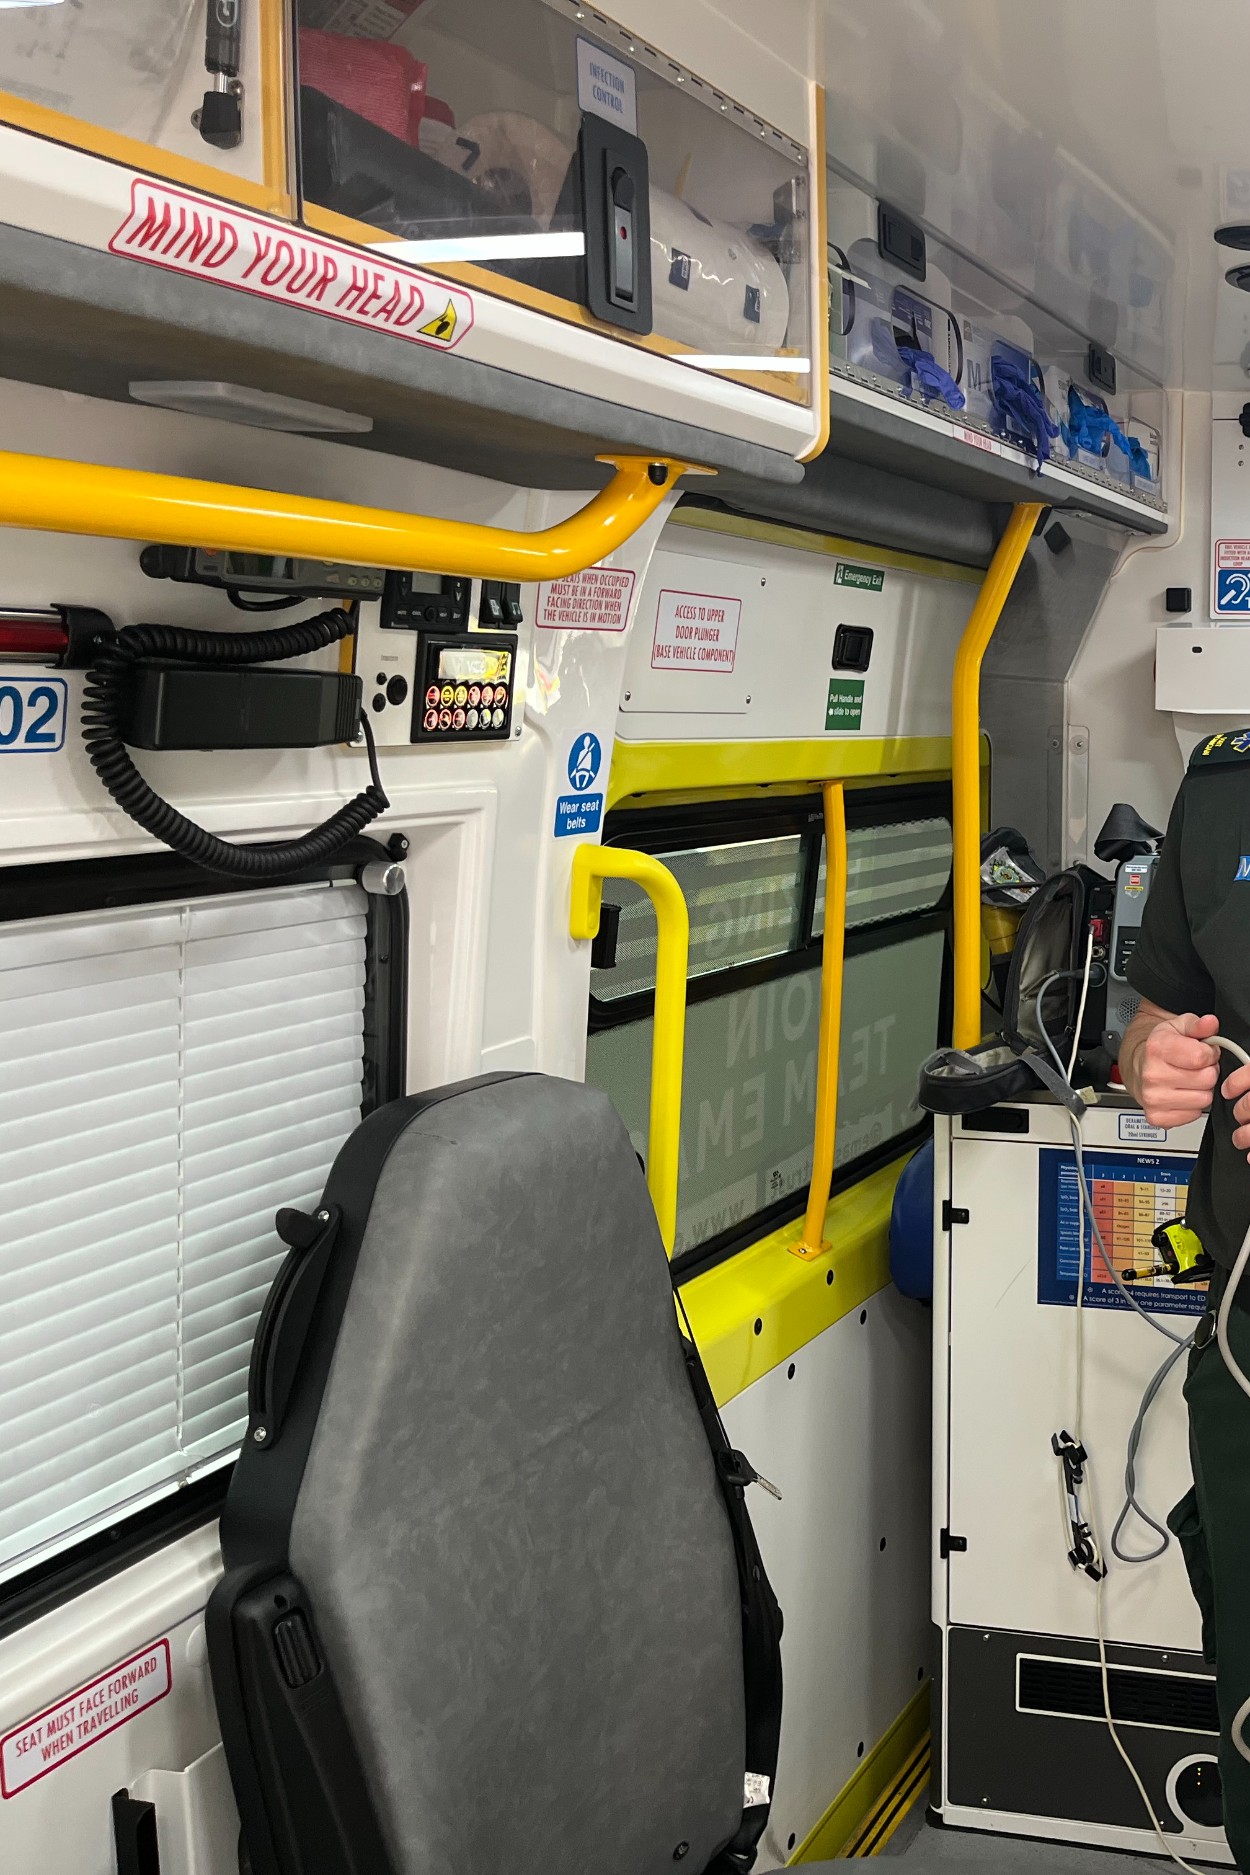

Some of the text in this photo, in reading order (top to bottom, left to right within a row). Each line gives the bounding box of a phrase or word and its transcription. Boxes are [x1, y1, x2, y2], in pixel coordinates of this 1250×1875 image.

[589, 62, 625, 94] INFECTION
[592, 84, 624, 114] CONTROL
[126, 196, 425, 327] MIND YOUR HEAD
[582, 571, 599, 586] WHEN
[599, 574, 629, 588] OCCUPIED
[844, 569, 882, 587] Emergency Exit
[550, 583, 622, 599] MUST BE IN A FORWARD
[547, 596, 621, 612] FACING DIRECTION WHEN
[543, 609, 621, 625] THE VEHICLE IS IN MOTION
[674, 604, 725, 623] ACCESS TO UPPER
[675, 625, 720, 643] DOOR PLUNGER
[653, 643, 735, 665] (BASE VEHICLE COMPONENT)
[830, 694, 862, 704] Pull Handle and
[834, 707, 861, 718] slide to open
[559, 799, 600, 815] Wear seat
[566, 816, 586, 830] belts
[1135, 1291, 1160, 1299] requires
[1161, 1293, 1188, 1301] transport
[1153, 1302, 1187, 1310] parameter
[15, 1656, 158, 1758] SEAT MUST FACE FORWARD
[40, 1689, 139, 1762] WHEN TRAVELLING
